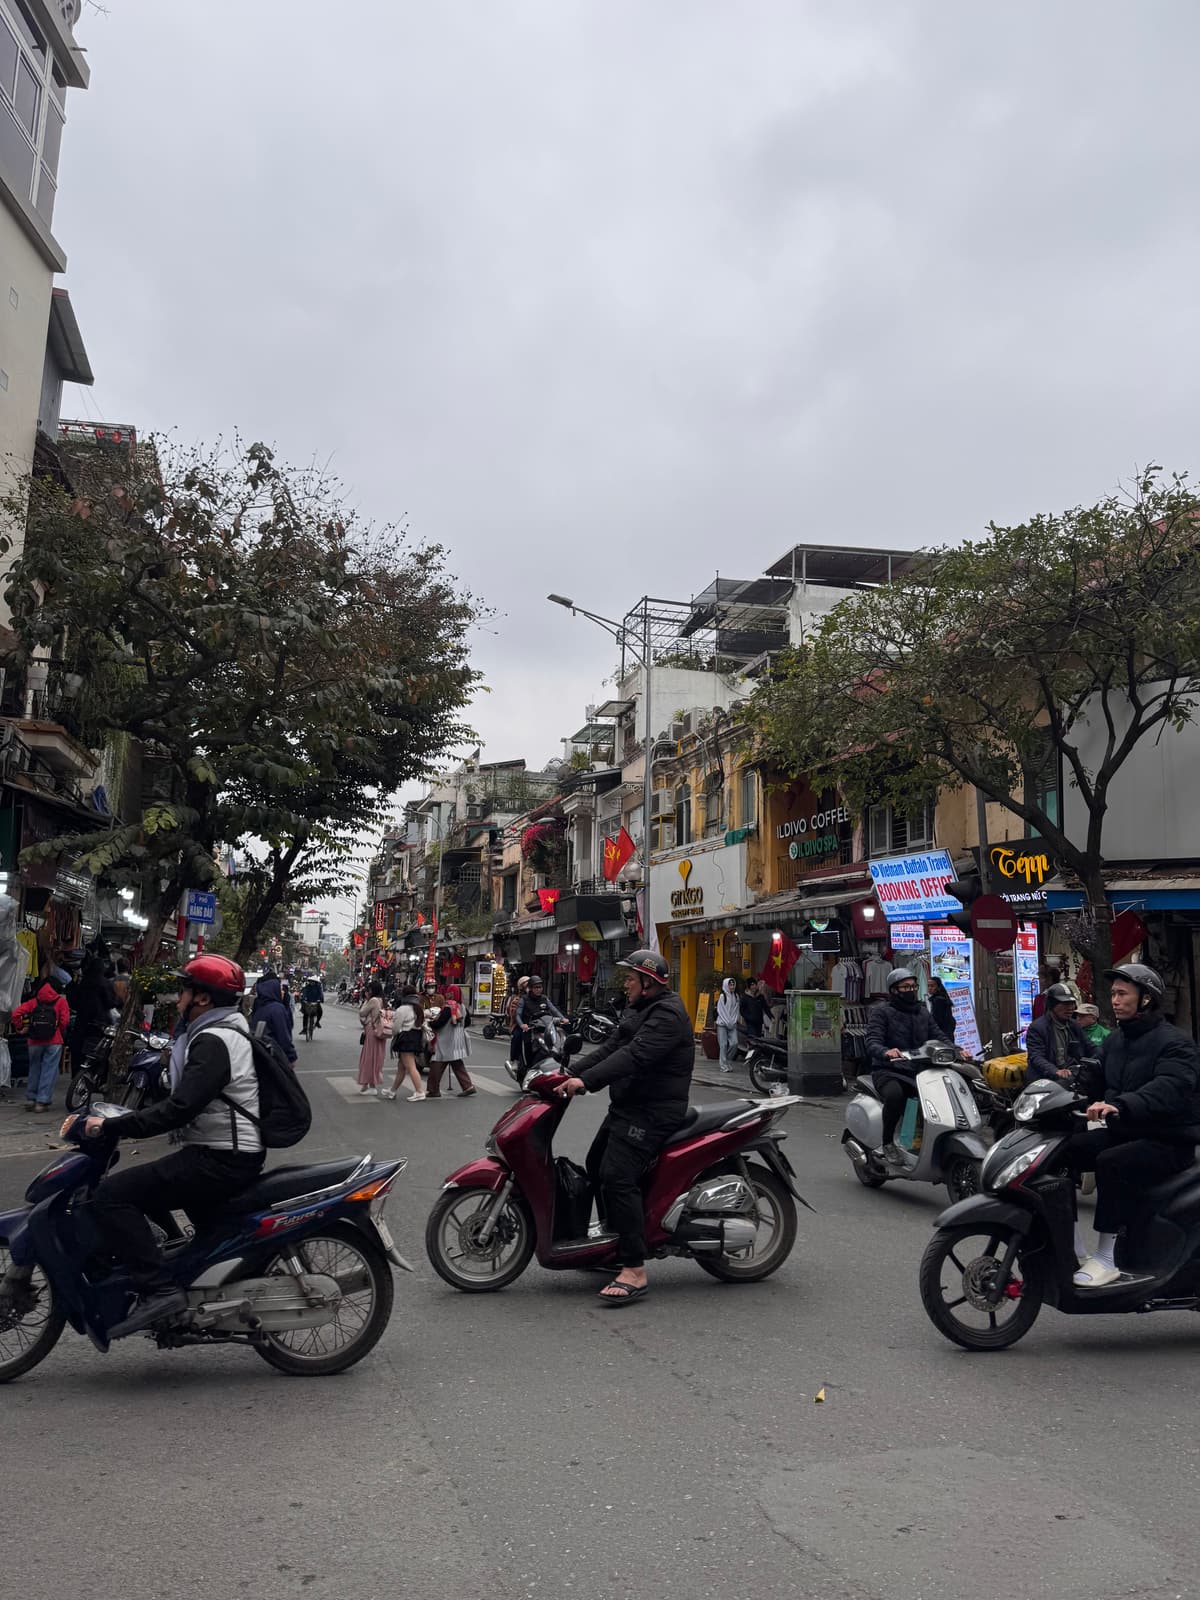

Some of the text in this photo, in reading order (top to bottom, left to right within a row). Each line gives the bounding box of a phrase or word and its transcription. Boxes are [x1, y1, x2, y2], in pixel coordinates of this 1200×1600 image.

[810, 807, 849, 830] COFFEE
[878, 853, 951, 878] Vietnam Buffalo Travel
[876, 879, 922, 902] BOOKING
